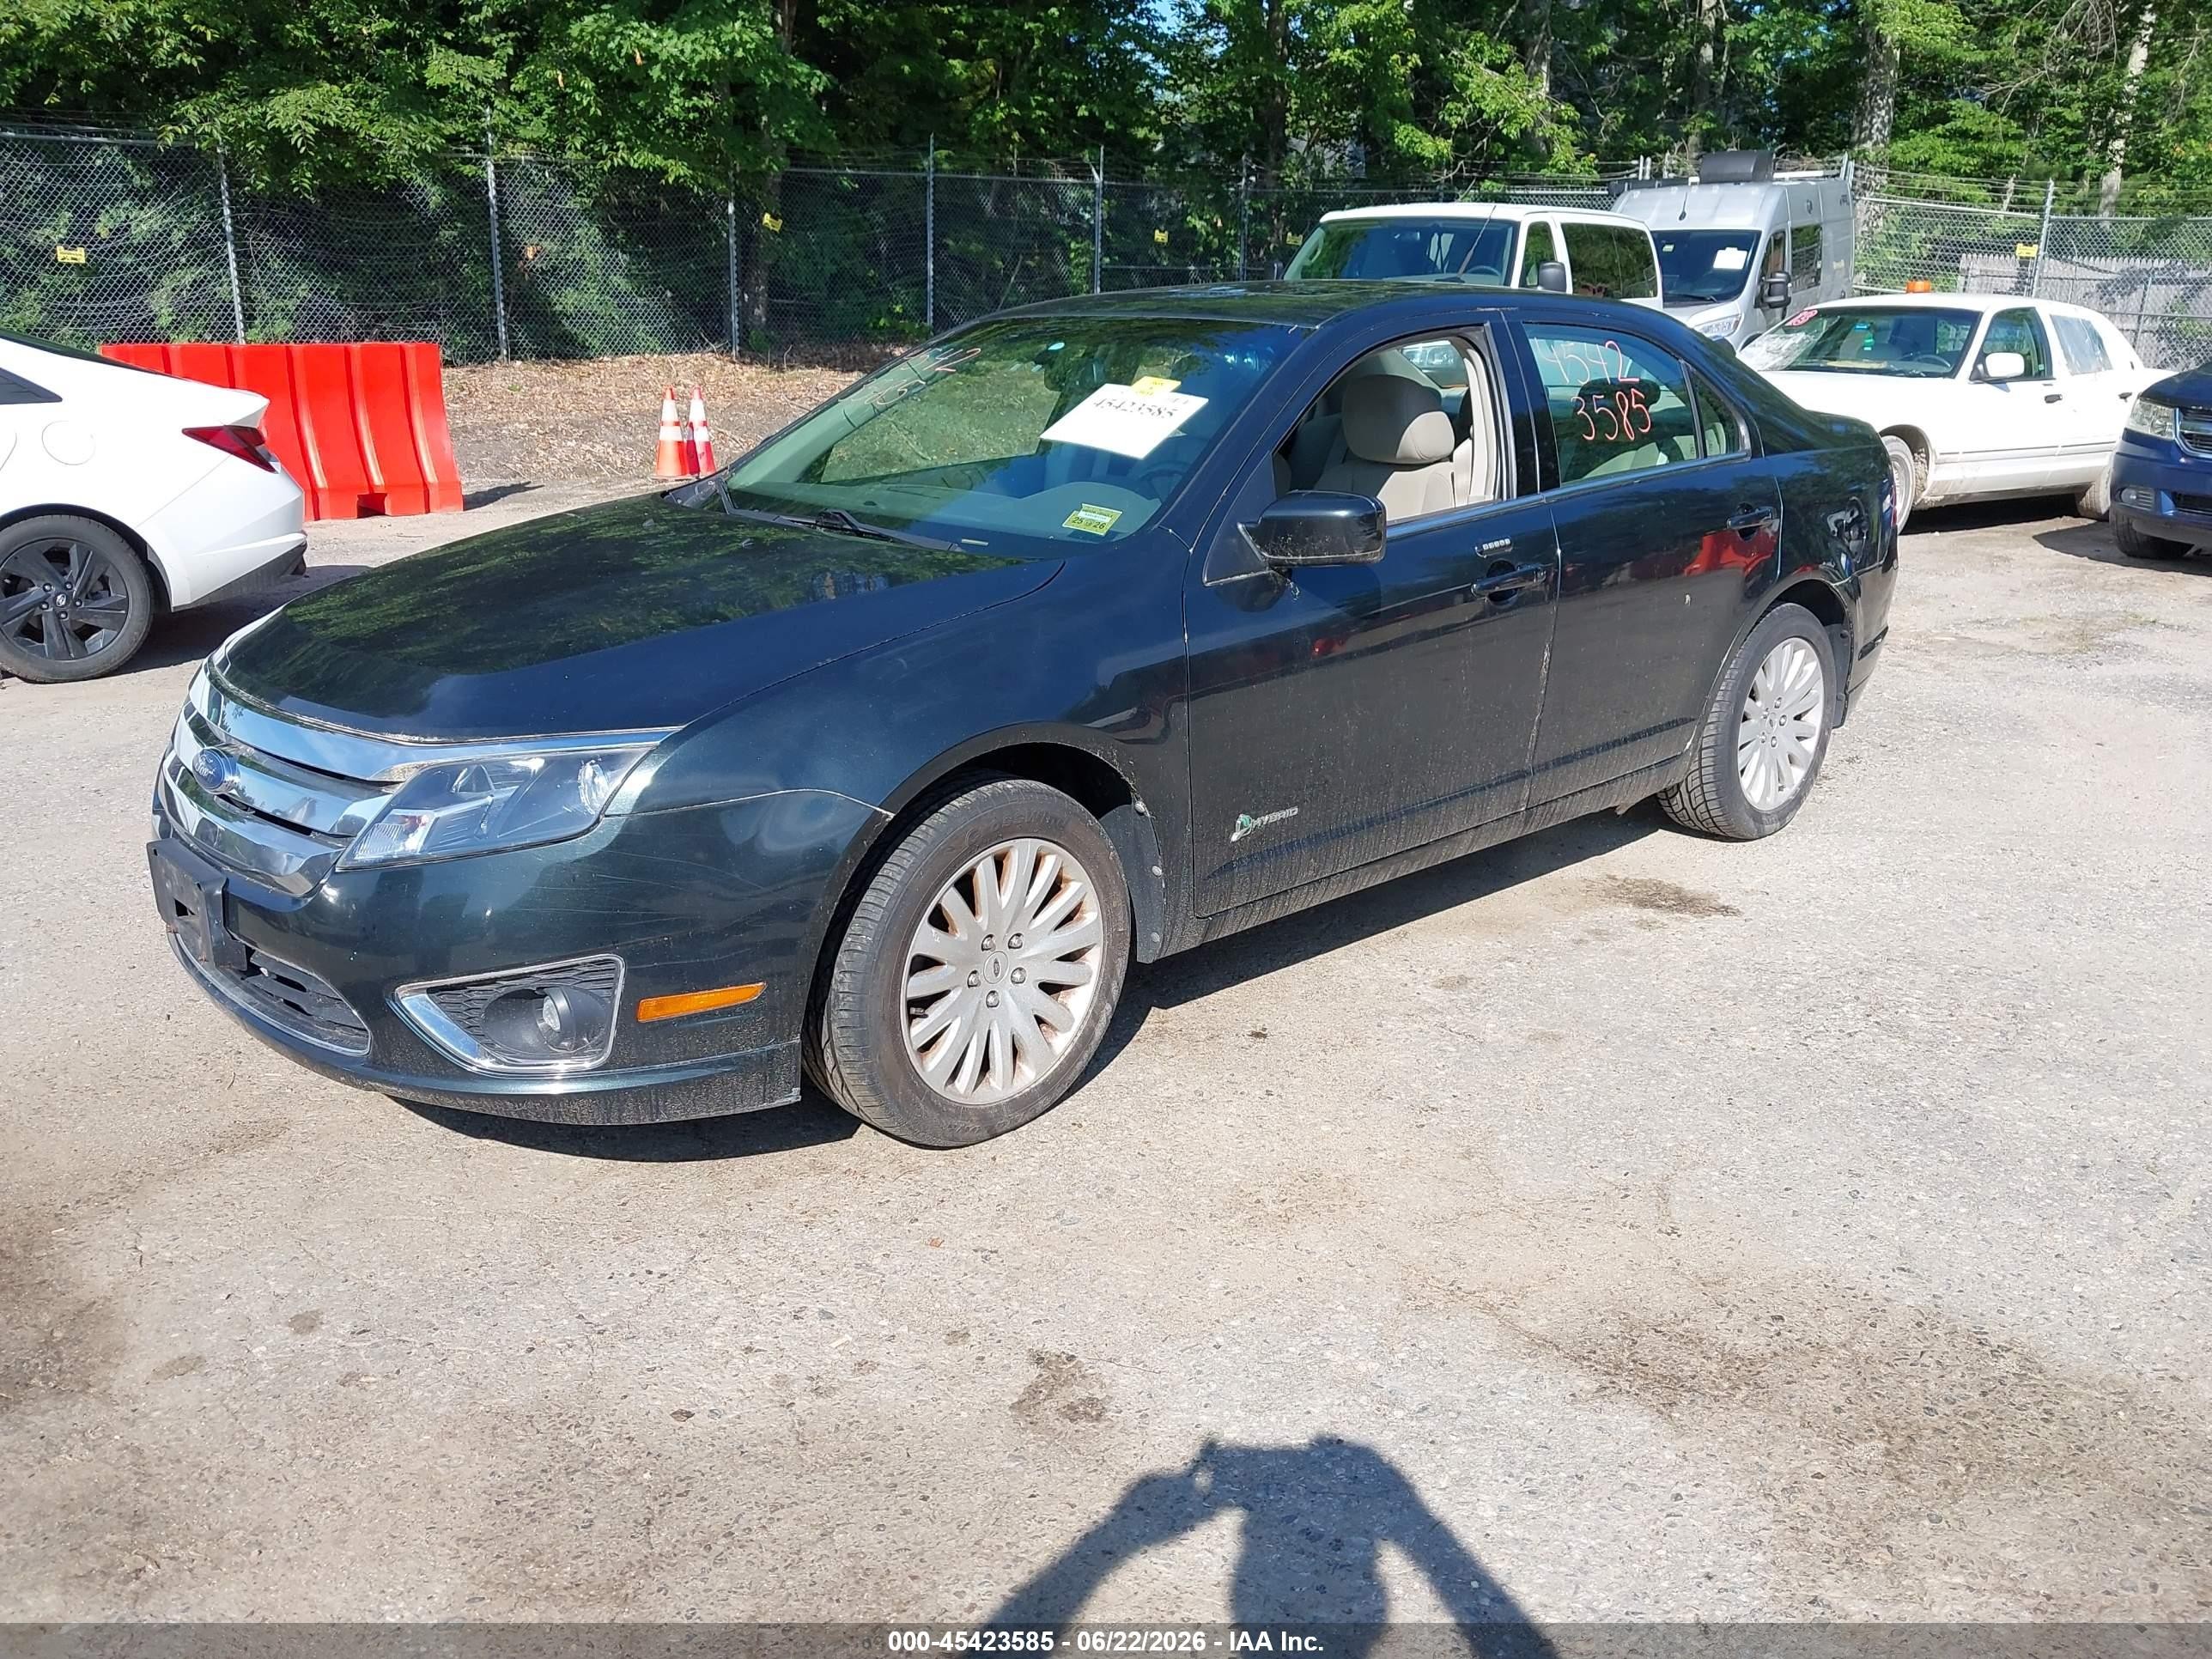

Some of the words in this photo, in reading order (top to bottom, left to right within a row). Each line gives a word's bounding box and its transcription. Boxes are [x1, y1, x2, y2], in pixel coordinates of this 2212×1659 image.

[1534, 337, 1639, 385] 4542
[1571, 387, 1651, 441] 3585
[1092, 521, 1107, 530] 26
[194, 755, 217, 777] Ford
[1251, 806, 1299, 829] HYBRID
